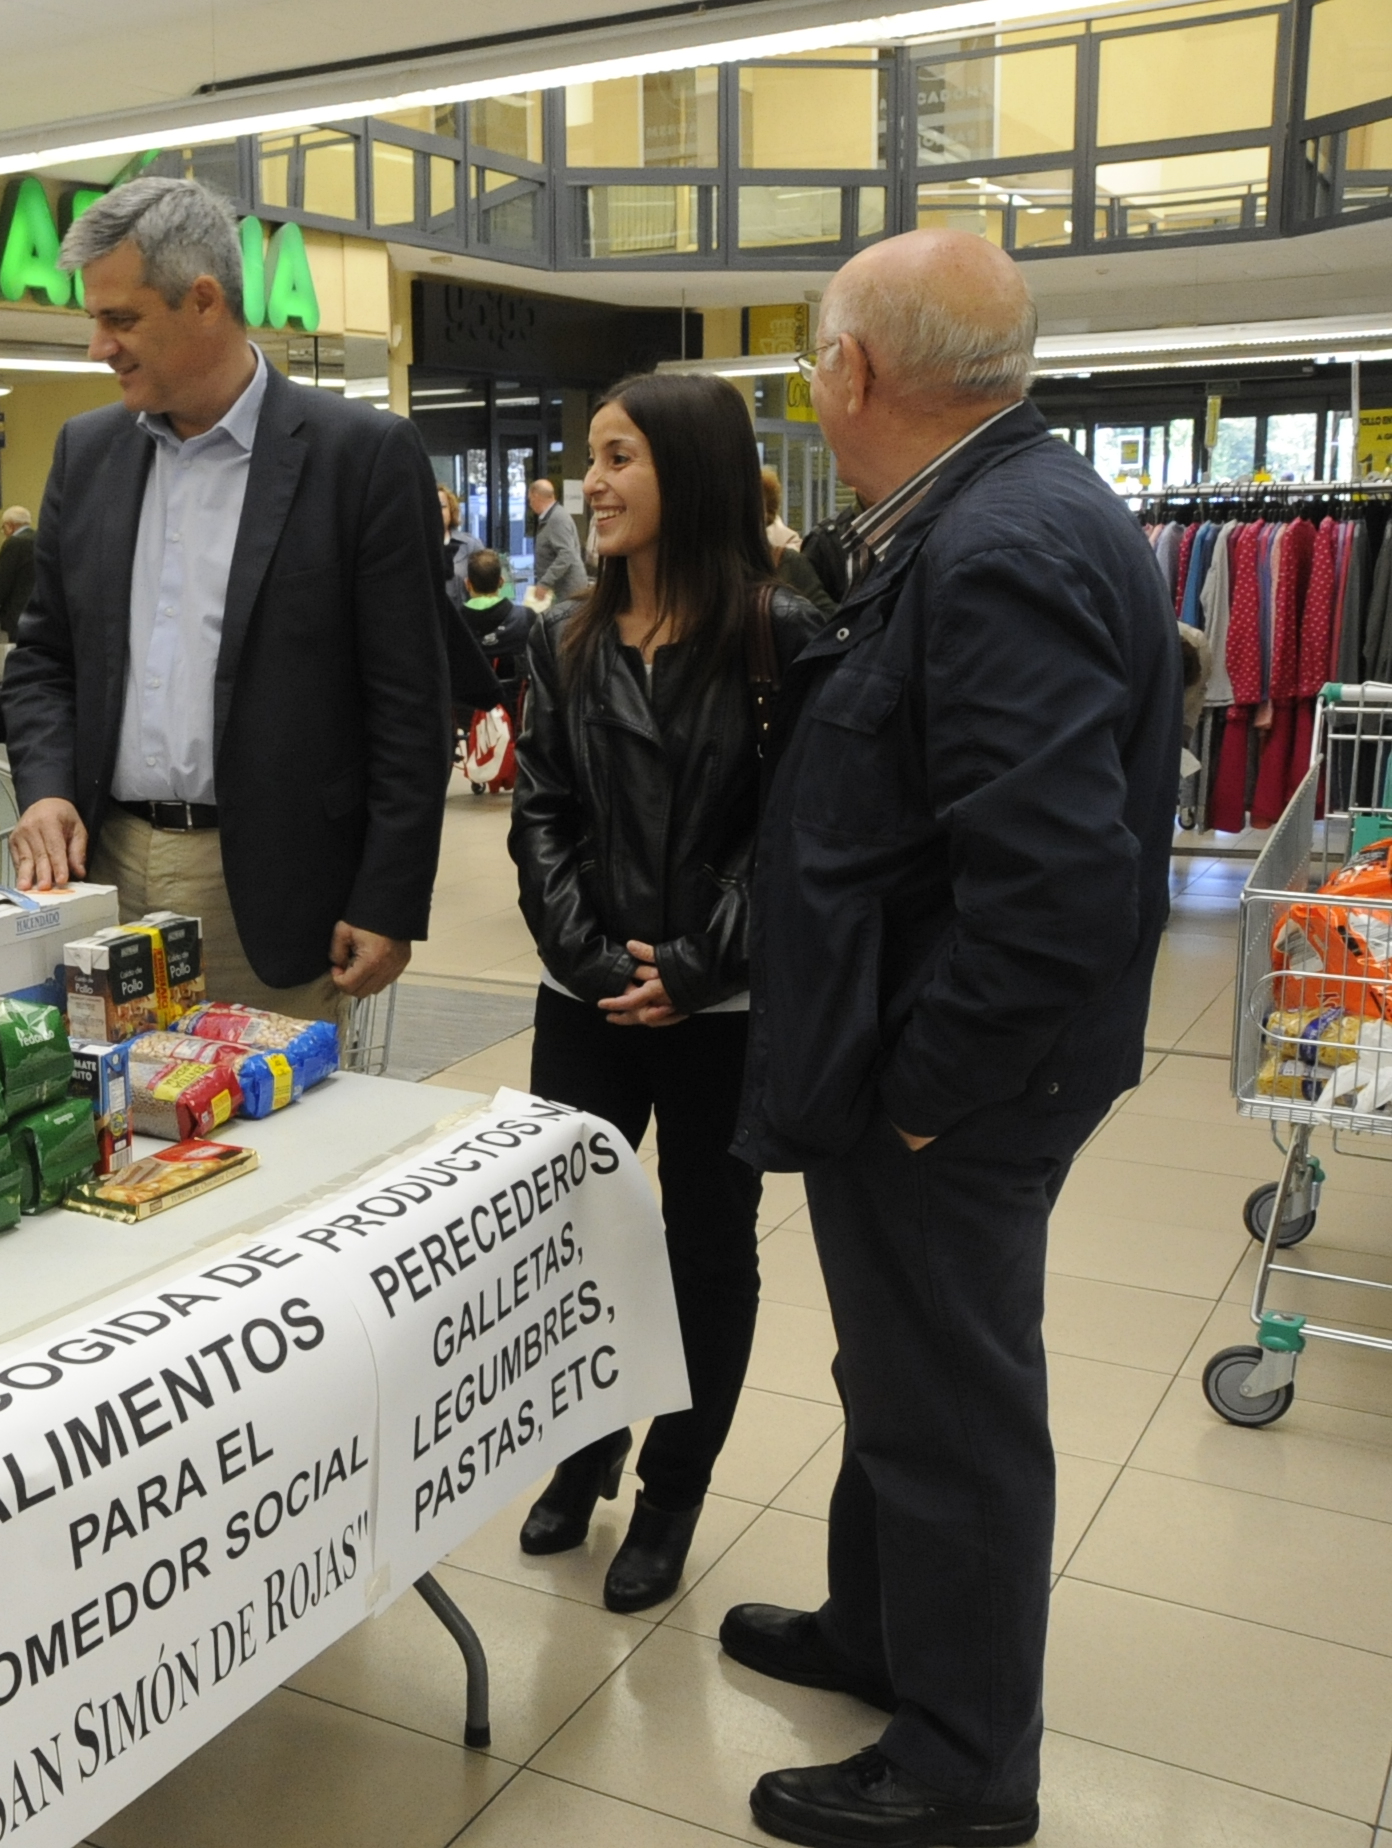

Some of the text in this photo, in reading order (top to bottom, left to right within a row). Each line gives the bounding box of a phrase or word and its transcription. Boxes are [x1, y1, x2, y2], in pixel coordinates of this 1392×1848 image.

[121, 978, 144, 996] Pollo
[200, 1244, 304, 1290] DE
[297, 1118, 544, 1254] PRODUCTOS
[369, 1131, 621, 1319] PERECEDEROS
[412, 1279, 616, 1462] LEGUMBRES,
[432, 1221, 584, 1368] GALLETAS,
[68, 1420, 275, 1571] PARA EL
[224, 1434, 370, 1561] SOCIAL
[414, 1345, 620, 1533] PASTAS, ETC
